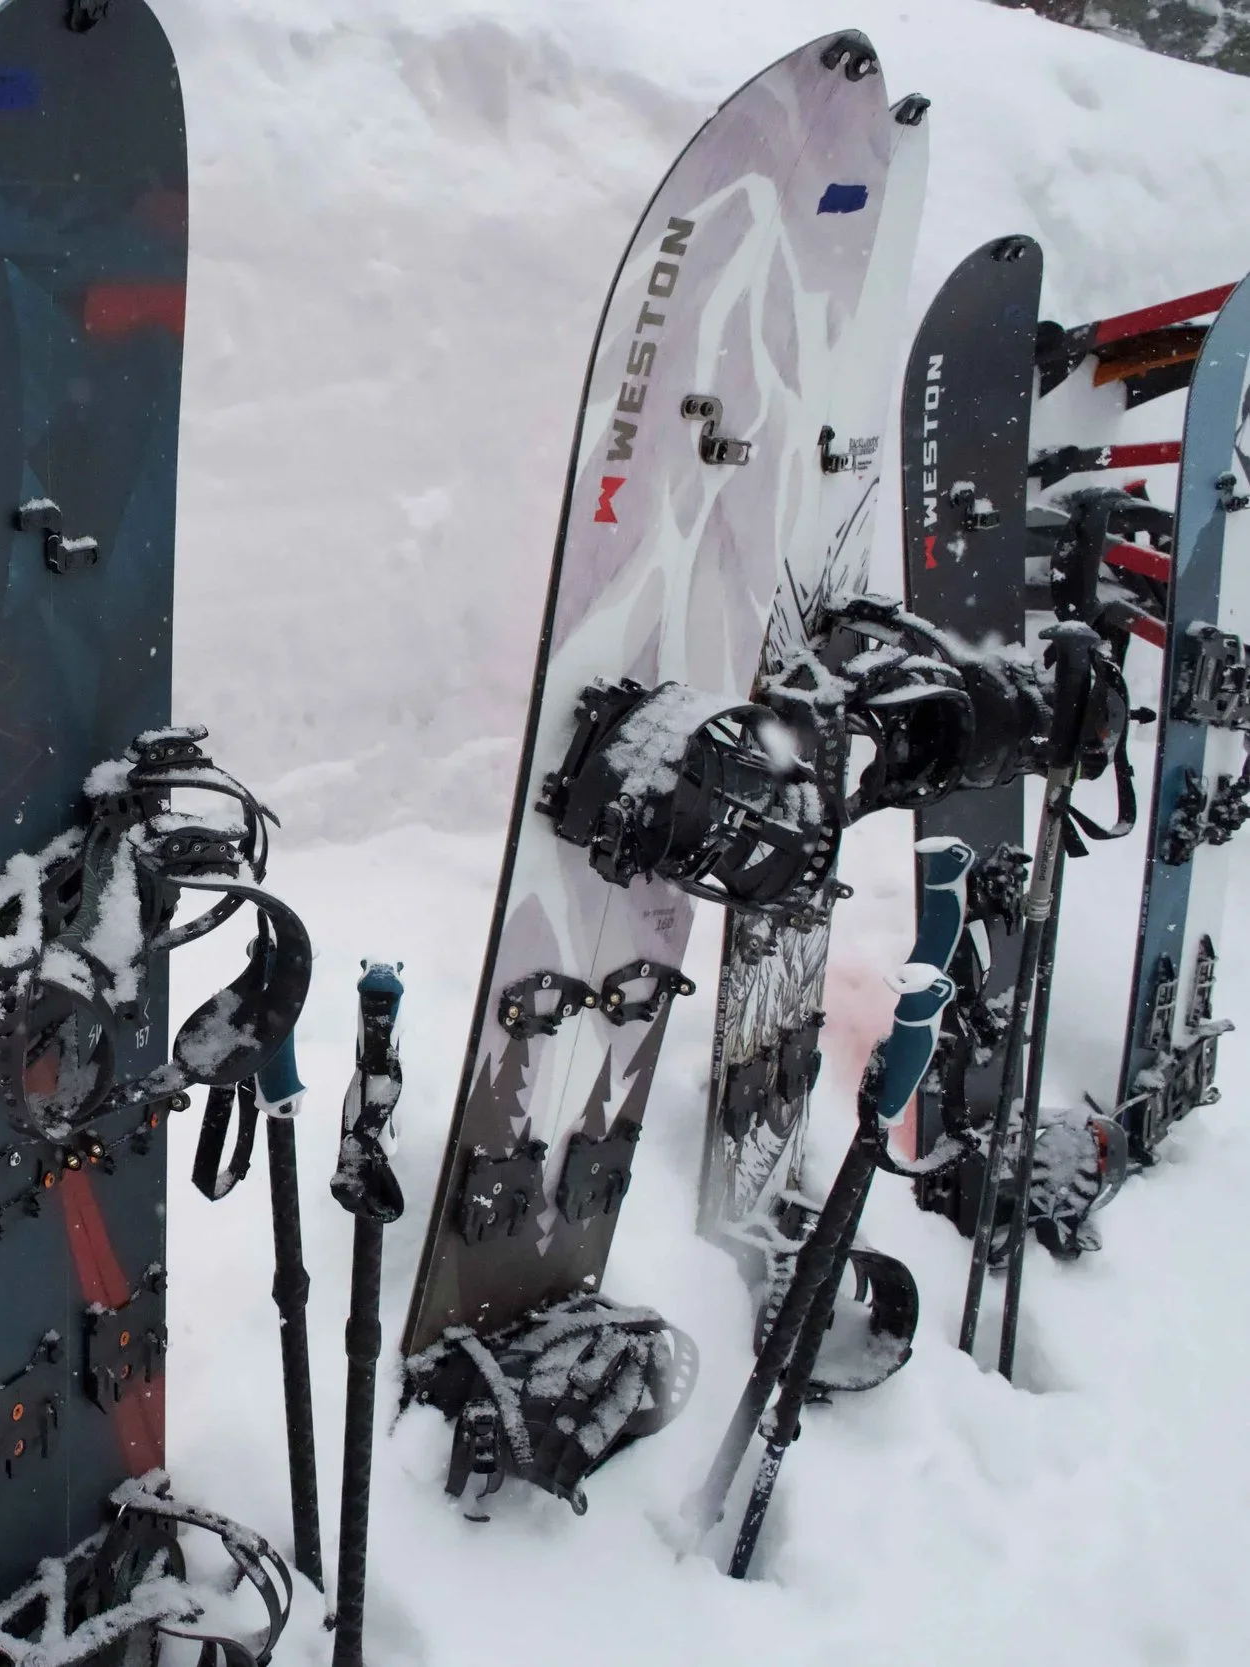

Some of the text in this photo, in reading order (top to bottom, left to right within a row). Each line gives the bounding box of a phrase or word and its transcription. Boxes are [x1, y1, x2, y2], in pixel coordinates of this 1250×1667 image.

[606, 216, 695, 461] WESTON
[923, 354, 944, 528] WESTON
[135, 1025, 150, 1049] 157
